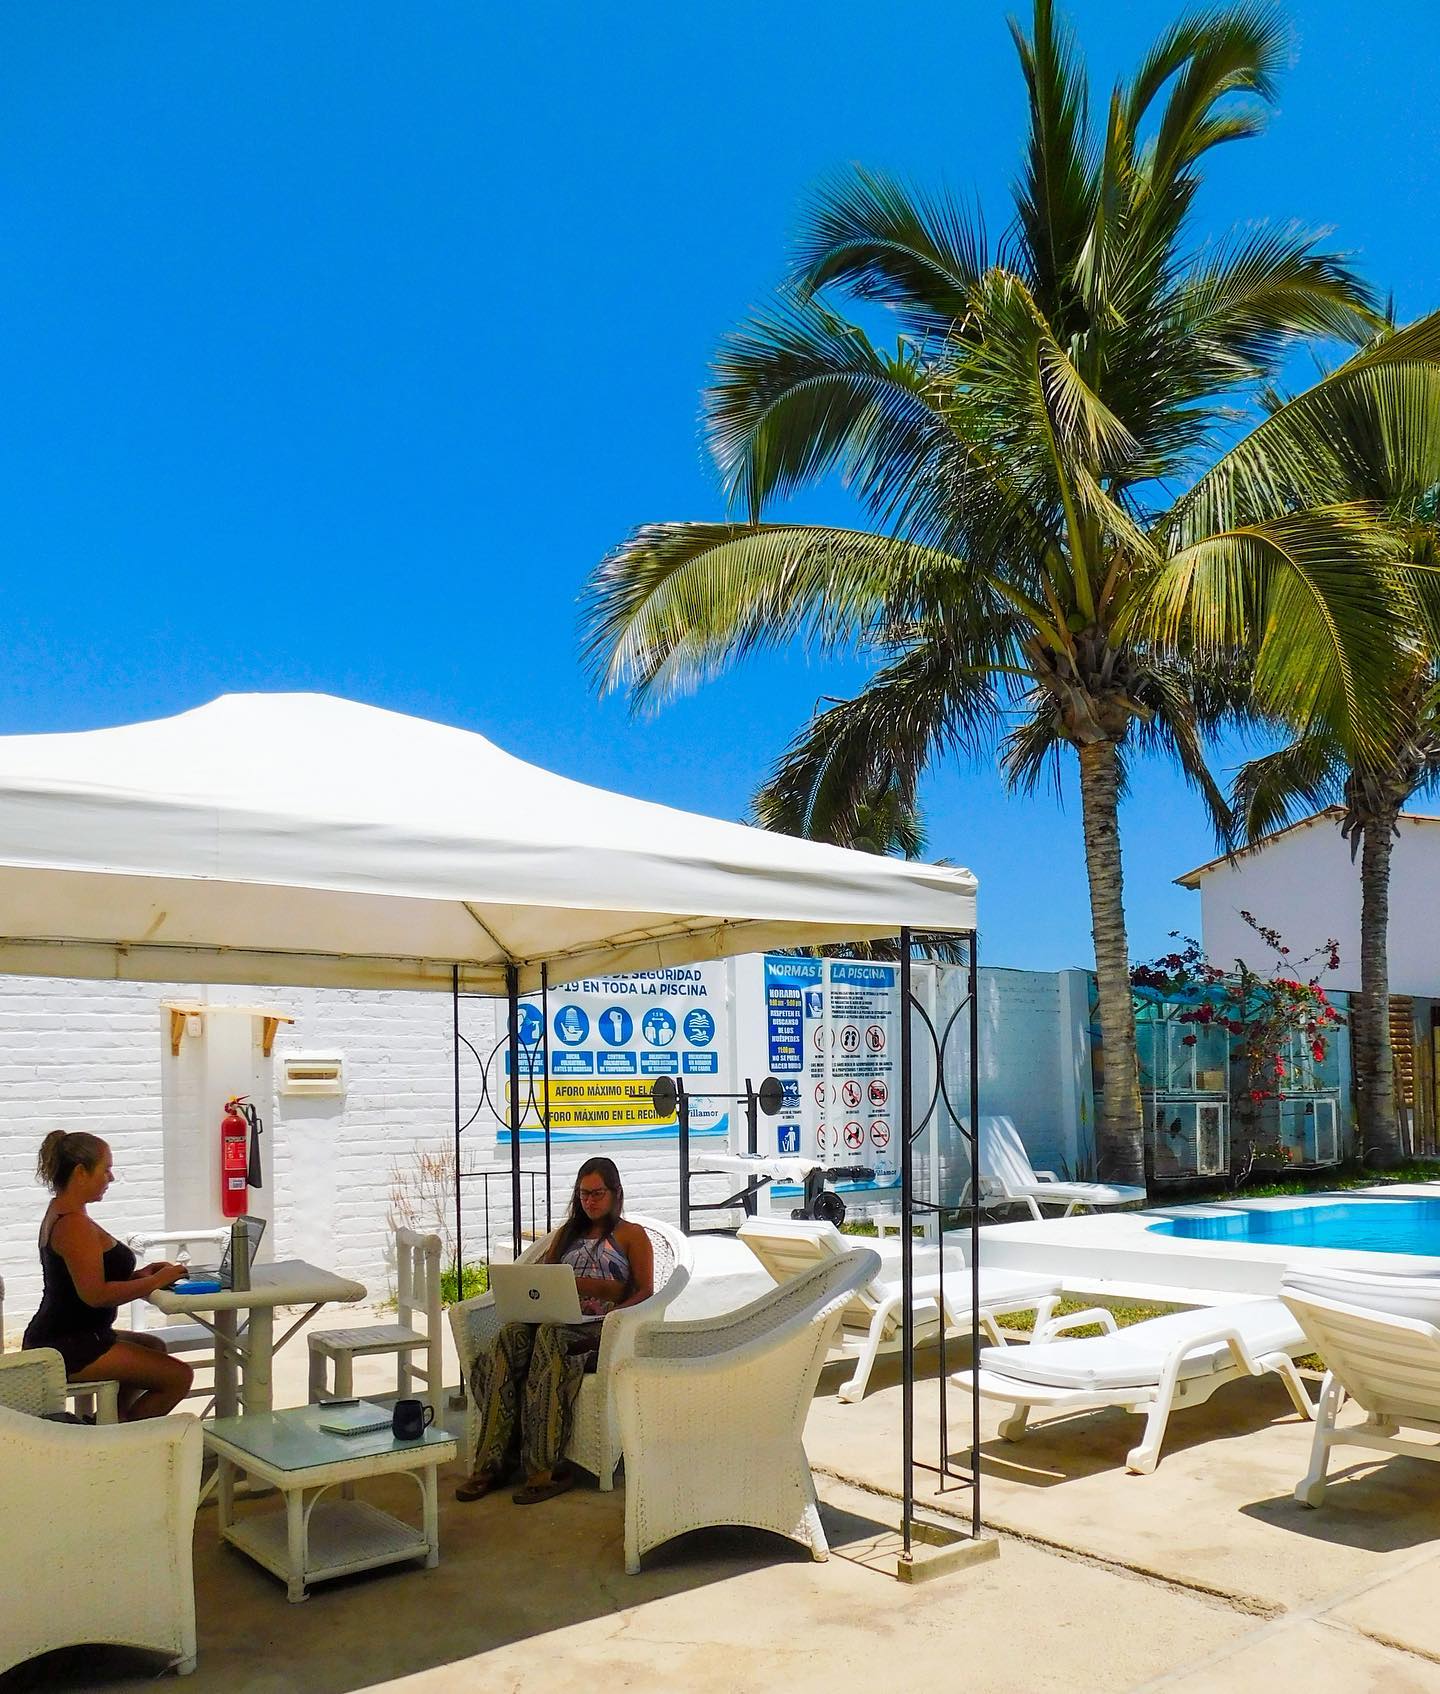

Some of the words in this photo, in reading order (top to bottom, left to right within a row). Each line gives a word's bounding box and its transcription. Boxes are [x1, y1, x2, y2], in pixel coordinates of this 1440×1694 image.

[768, 964, 816, 978] NORMAS
[833, 966, 847, 979] LA
[848, 969, 886, 981] PISCINA
[583, 981, 600, 993] EN
[602, 982, 638, 995] TODA
[641, 984, 657, 996] LA
[659, 983, 708, 997] PISCINA
[769, 988, 801, 999] HORARIO
[555, 1086, 584, 1097] AFORO
[587, 1083, 621, 1096] MÁXIMO
[624, 1085, 636, 1096] EN
[638, 1085, 648, 1096] EL
[574, 1108, 608, 1121] MÁXIMO
[611, 1110, 622, 1120] EN
[624, 1109, 635, 1119] EL
